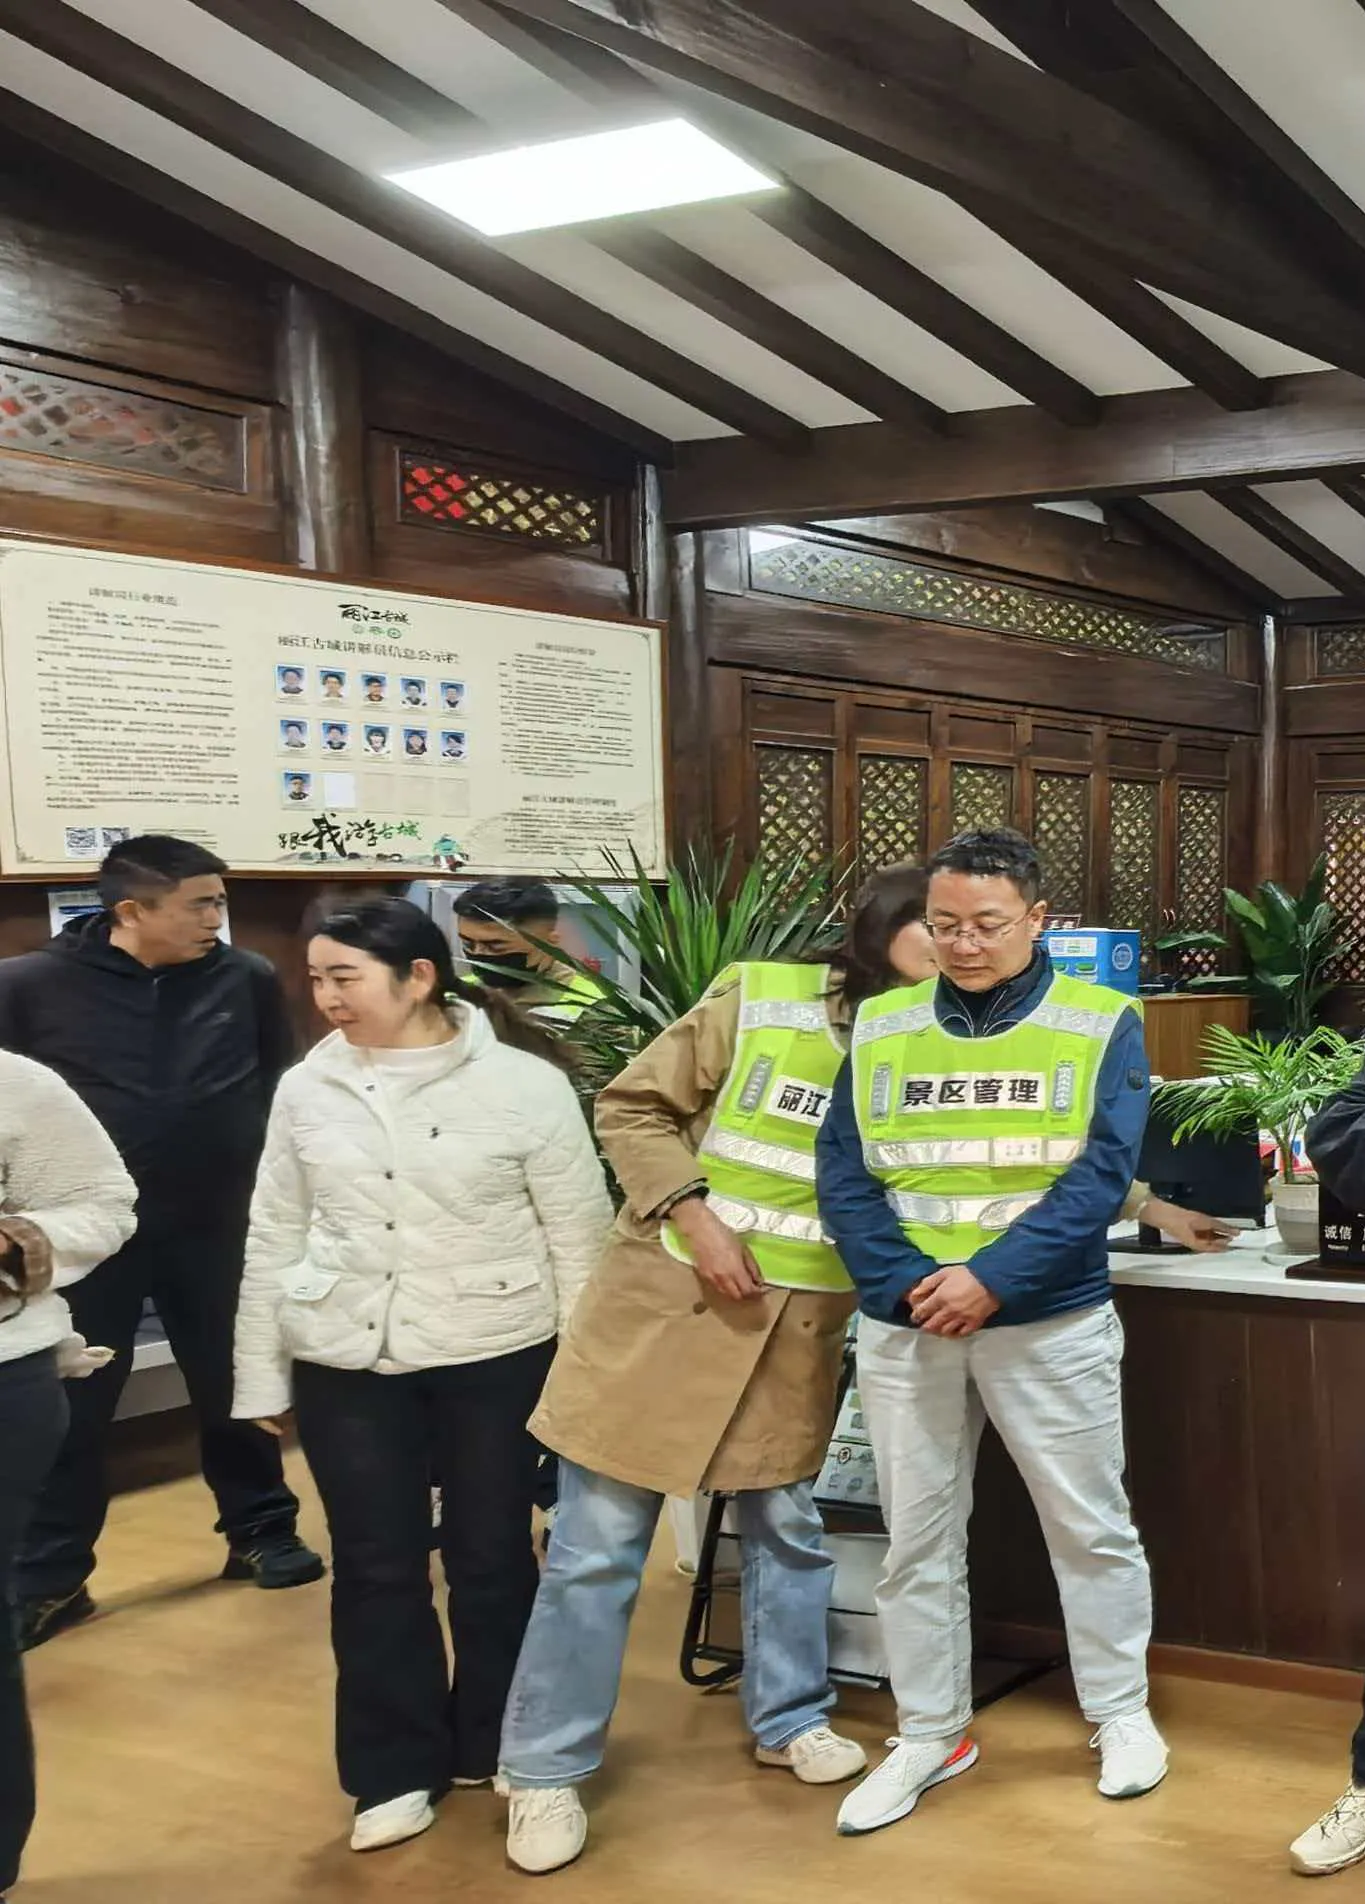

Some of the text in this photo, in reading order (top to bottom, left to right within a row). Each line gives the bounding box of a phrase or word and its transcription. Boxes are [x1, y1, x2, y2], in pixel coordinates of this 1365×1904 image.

[777, 1084, 832, 1117] 丽江
[903, 1078, 1039, 1106] 景区管理
